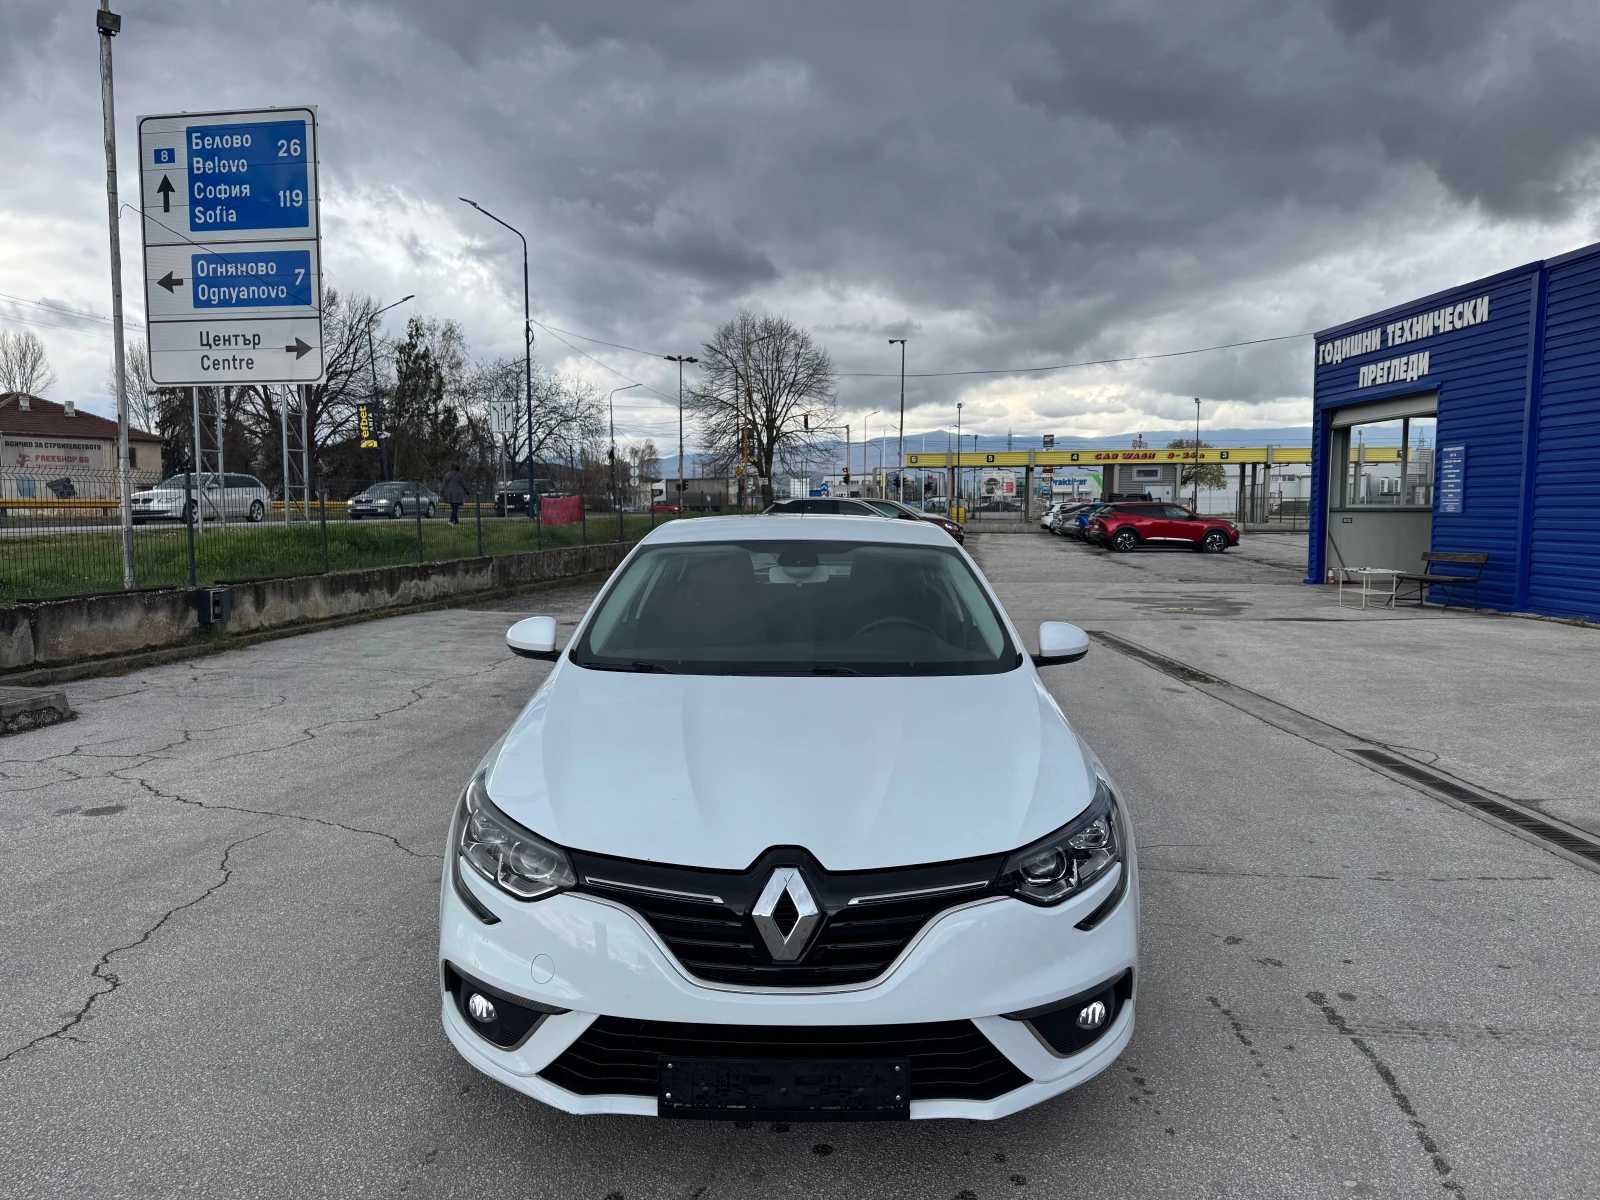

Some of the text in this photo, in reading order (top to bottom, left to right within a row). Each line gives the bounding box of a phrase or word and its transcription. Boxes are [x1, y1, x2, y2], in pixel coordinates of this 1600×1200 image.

[191, 133, 252, 150] Белово
[277, 139, 301, 157] 26
[161, 150, 169, 162] 8
[193, 156, 248, 175] Belovo
[194, 182, 251, 200] София
[279, 189, 303, 208] 119
[194, 206, 237, 224] Sofia
[197, 259, 277, 277] Огняново
[294, 268, 306, 286] 7
[198, 284, 287, 304] Ognyanovo
[1318, 295, 1490, 366] ГОДИШНИ ТЕХНИЧЕСКИ
[199, 331, 261, 350] Център
[200, 354, 255, 371] Centre
[1358, 351, 1430, 389] ПРЕГЛЕДИ
[358, 405, 370, 438] efbet
[5, 440, 33, 448] ВСИЧКО
[34, 441, 44, 449] ЗА
[1095, 452, 1119, 460] CAR
[1122, 452, 1156, 460] WASH
